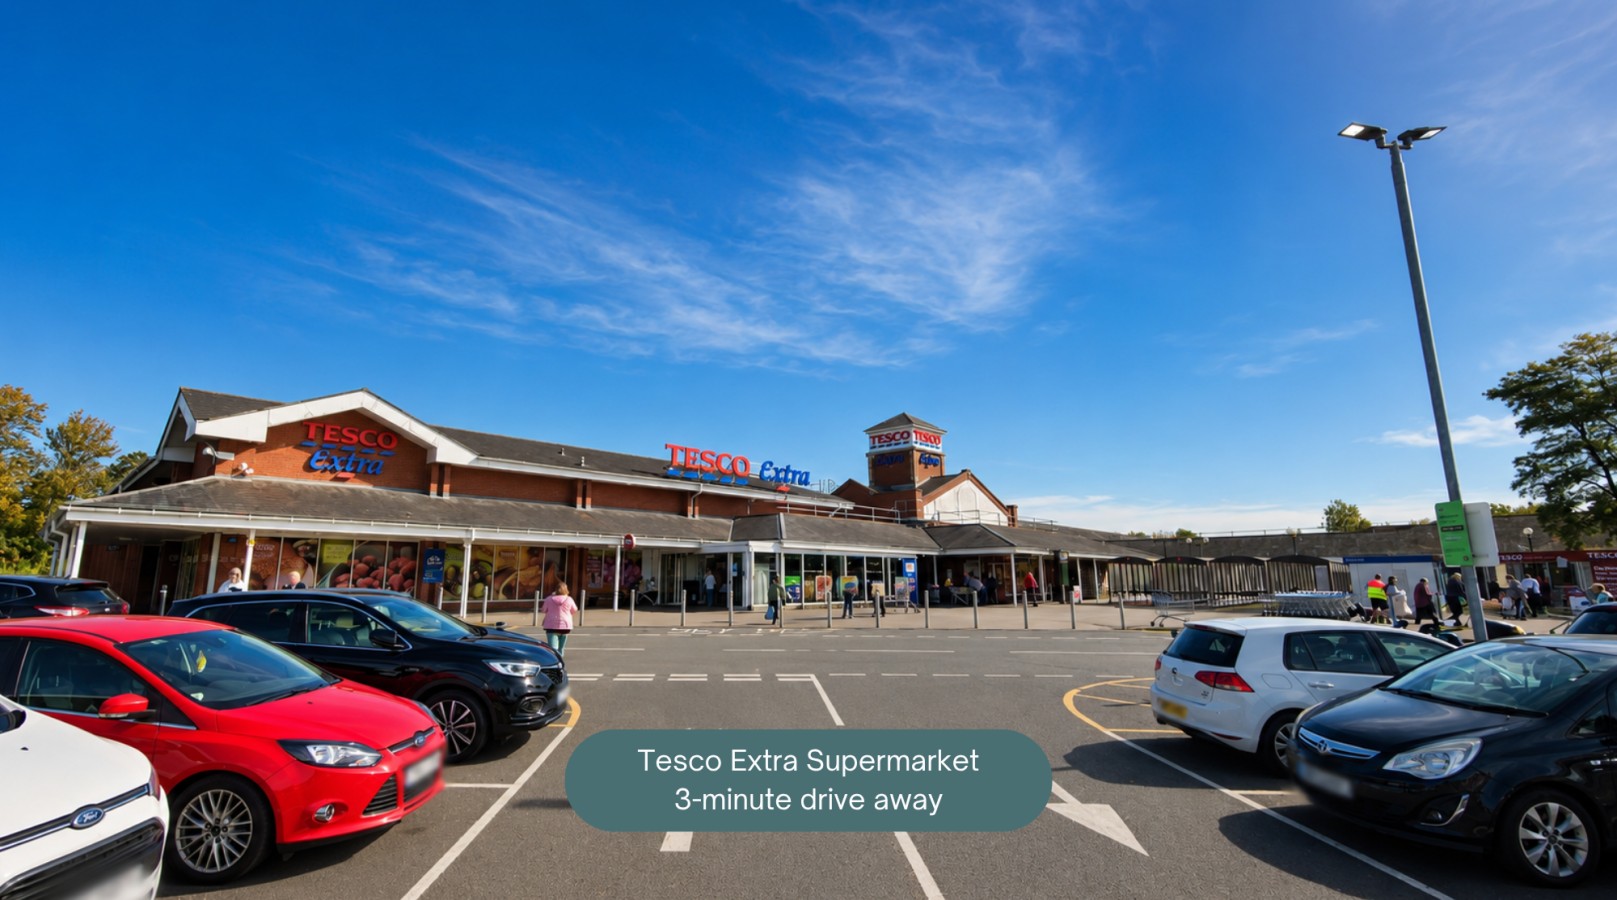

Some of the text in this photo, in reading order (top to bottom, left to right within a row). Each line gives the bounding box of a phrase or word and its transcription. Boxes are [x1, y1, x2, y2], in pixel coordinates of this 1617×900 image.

[303, 421, 398, 450] TESCO
[870, 430, 911, 445] TESCO
[913, 429, 942, 446] TESCO
[309, 449, 385, 475] Extra
[665, 443, 812, 487] TESCO Extra
